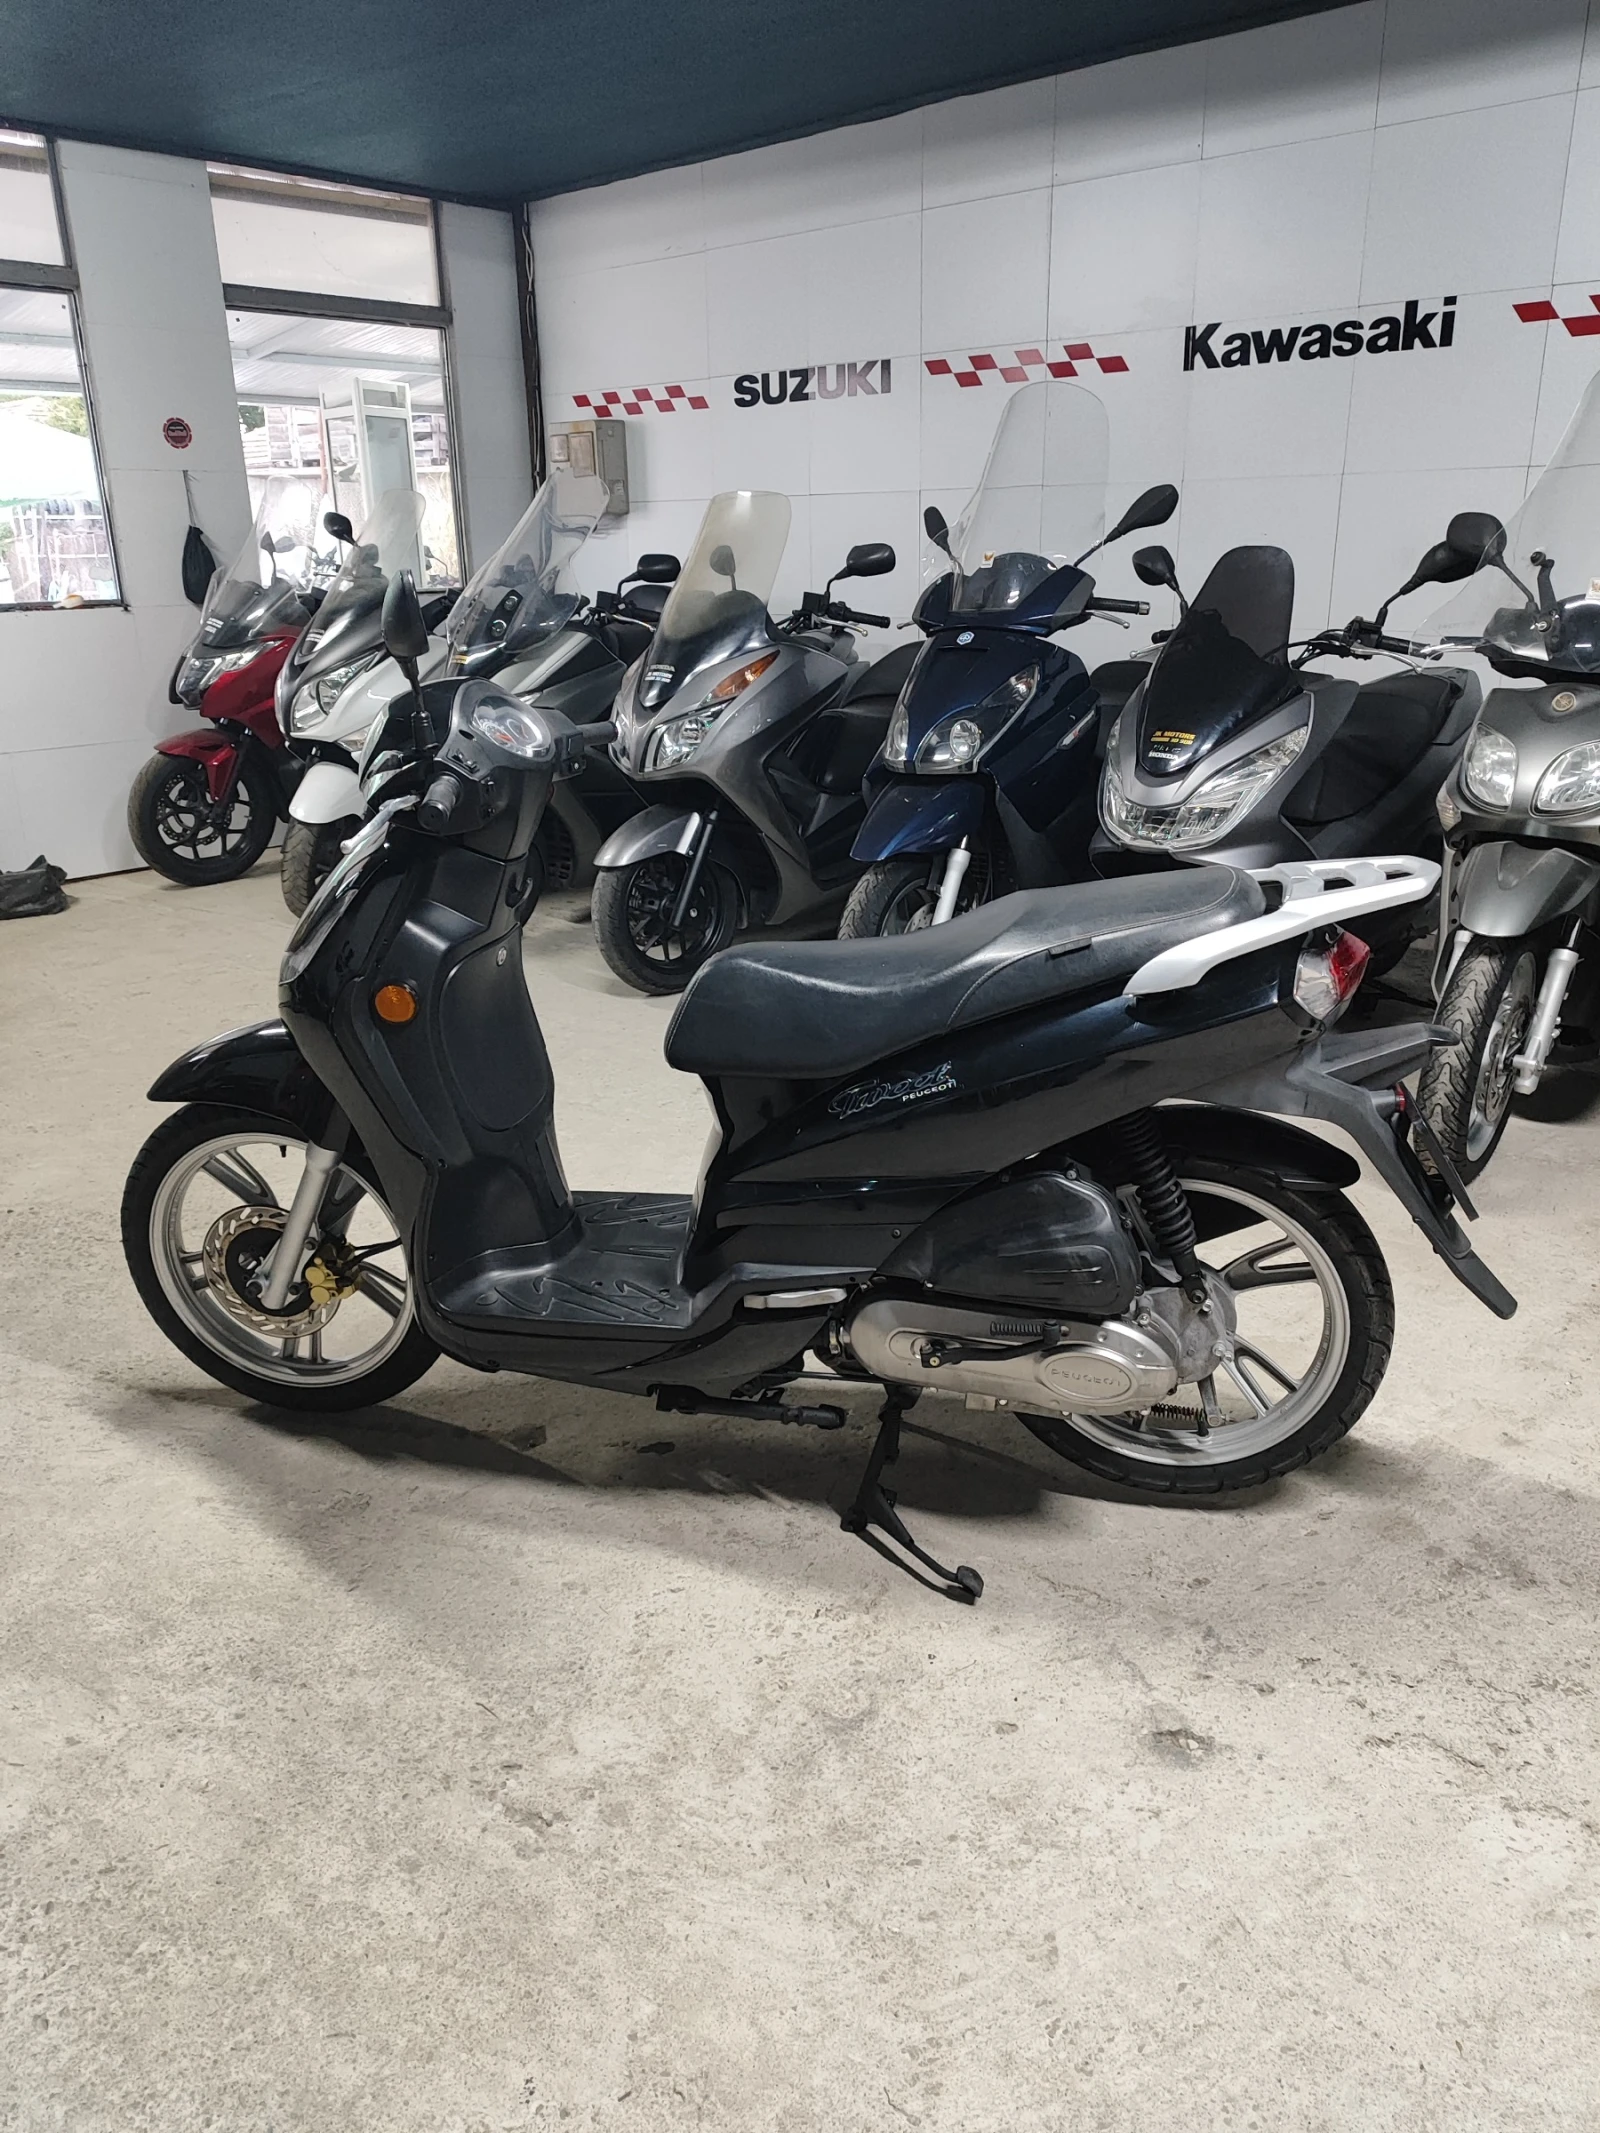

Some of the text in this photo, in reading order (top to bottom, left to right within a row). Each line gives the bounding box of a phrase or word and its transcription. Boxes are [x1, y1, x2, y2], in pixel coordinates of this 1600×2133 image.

[1183, 295, 1458, 372] Kawasaki
[734, 358, 892, 408] SUZUKI
[1163, 731, 1196, 740] MOTORS
[1148, 751, 1179, 760] HONDA
[902, 1079, 956, 1102] PEUGEOT
